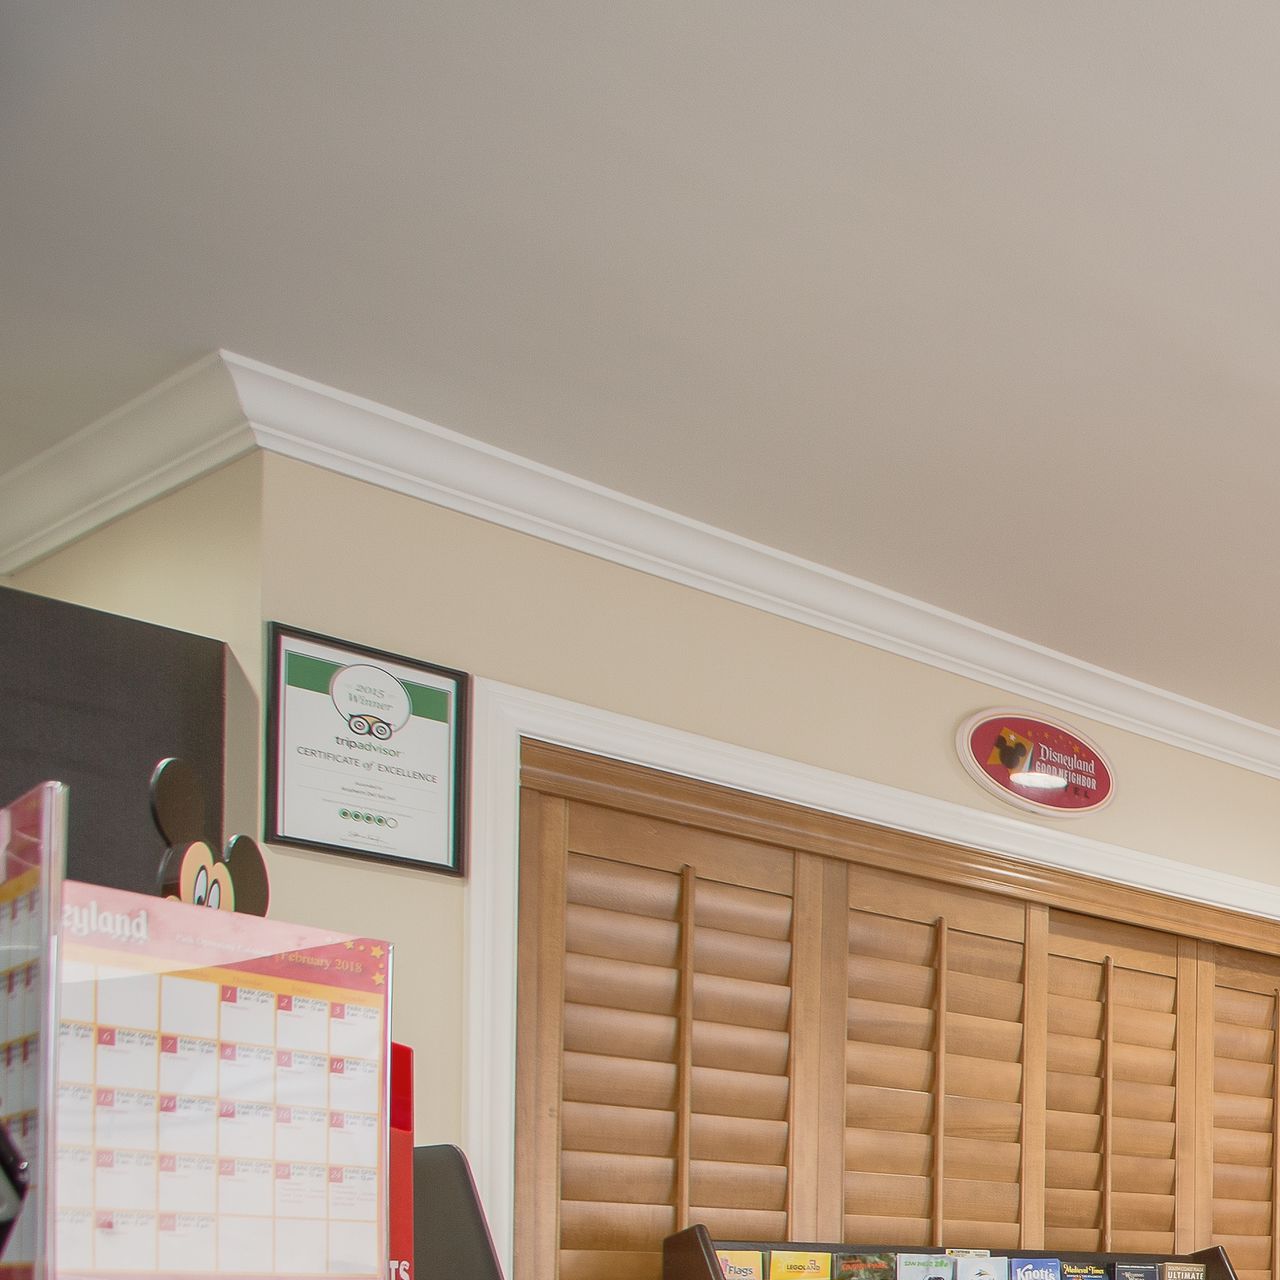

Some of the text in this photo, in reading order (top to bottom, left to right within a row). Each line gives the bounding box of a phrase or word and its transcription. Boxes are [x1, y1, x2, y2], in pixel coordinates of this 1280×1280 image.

[336, 735, 401, 758] tripadvisor
[297, 745, 360, 768] CERTIFICATE
[378, 763, 438, 784] EXCELLENCE
[1038, 742, 1095, 774] Disneyland
[281, 952, 363, 974] February 2018
[728, 1265, 754, 1277] Flags
[786, 1263, 820, 1272] LEGOLAND
[1063, 1263, 1089, 1275] Medieval
[1167, 1271, 1205, 1280] ULTIMATE
